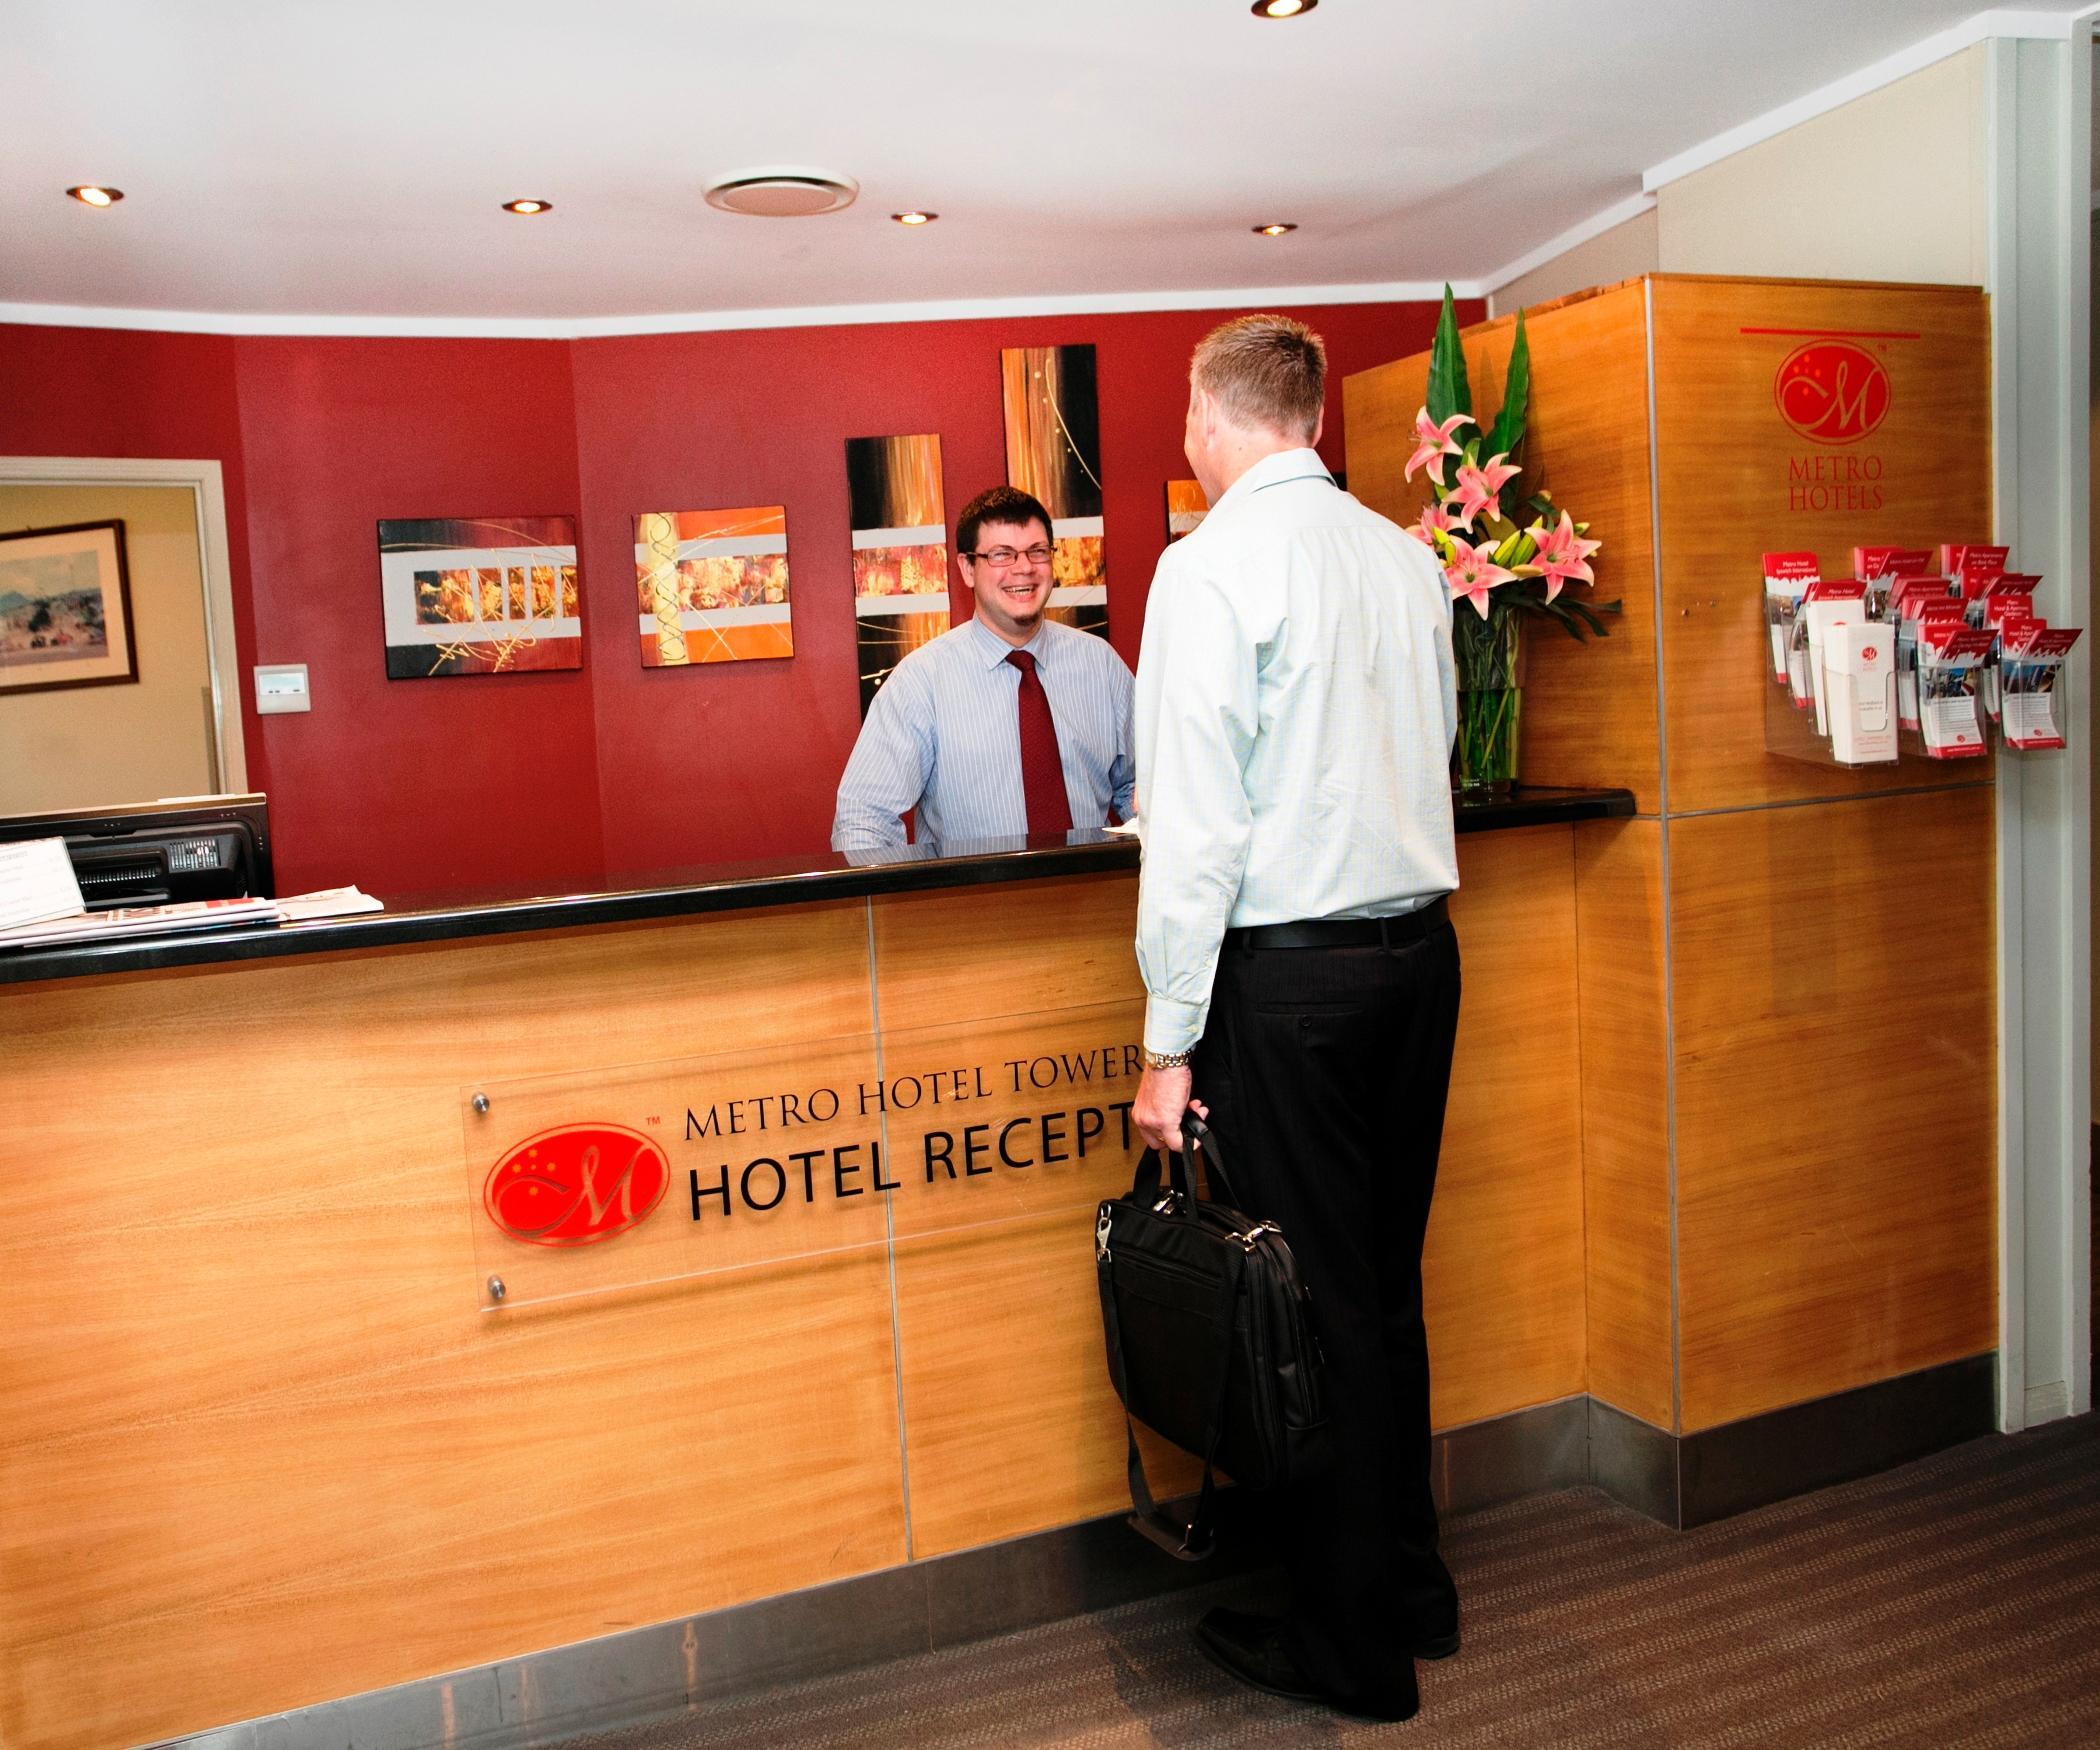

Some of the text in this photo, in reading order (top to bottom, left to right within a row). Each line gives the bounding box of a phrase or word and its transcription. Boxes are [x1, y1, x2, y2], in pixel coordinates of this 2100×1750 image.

[1788, 455, 1883, 481] METRO
[1788, 484, 1884, 512] HOTELS
[684, 1044, 1145, 1141] METRO HOTEL TOWER
[689, 1101, 1135, 1221] HOTEL RECEPT
